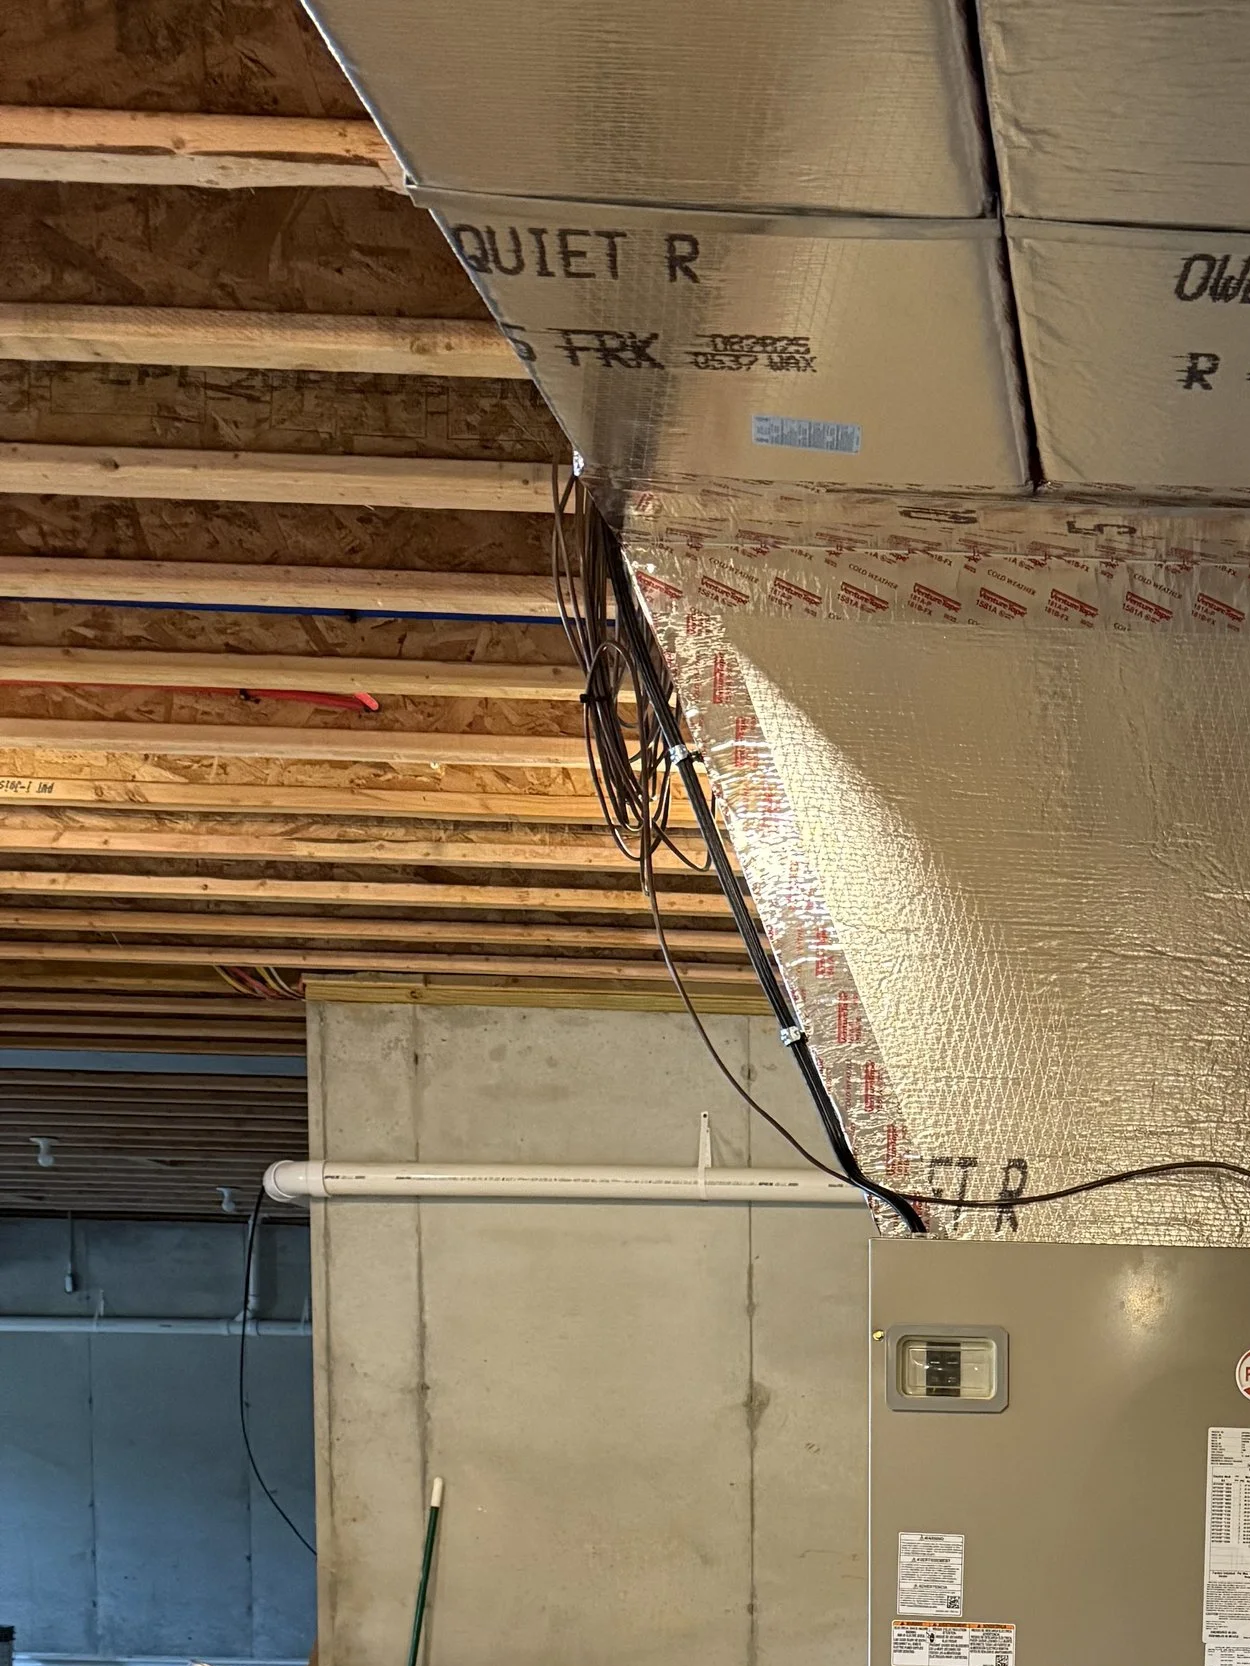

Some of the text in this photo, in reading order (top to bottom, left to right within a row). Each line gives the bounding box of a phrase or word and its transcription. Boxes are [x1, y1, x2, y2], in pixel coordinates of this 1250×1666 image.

[451, 223, 701, 284] QUIET R
[550, 327, 664, 369] FRK
[1174, 352, 1220, 390] R
